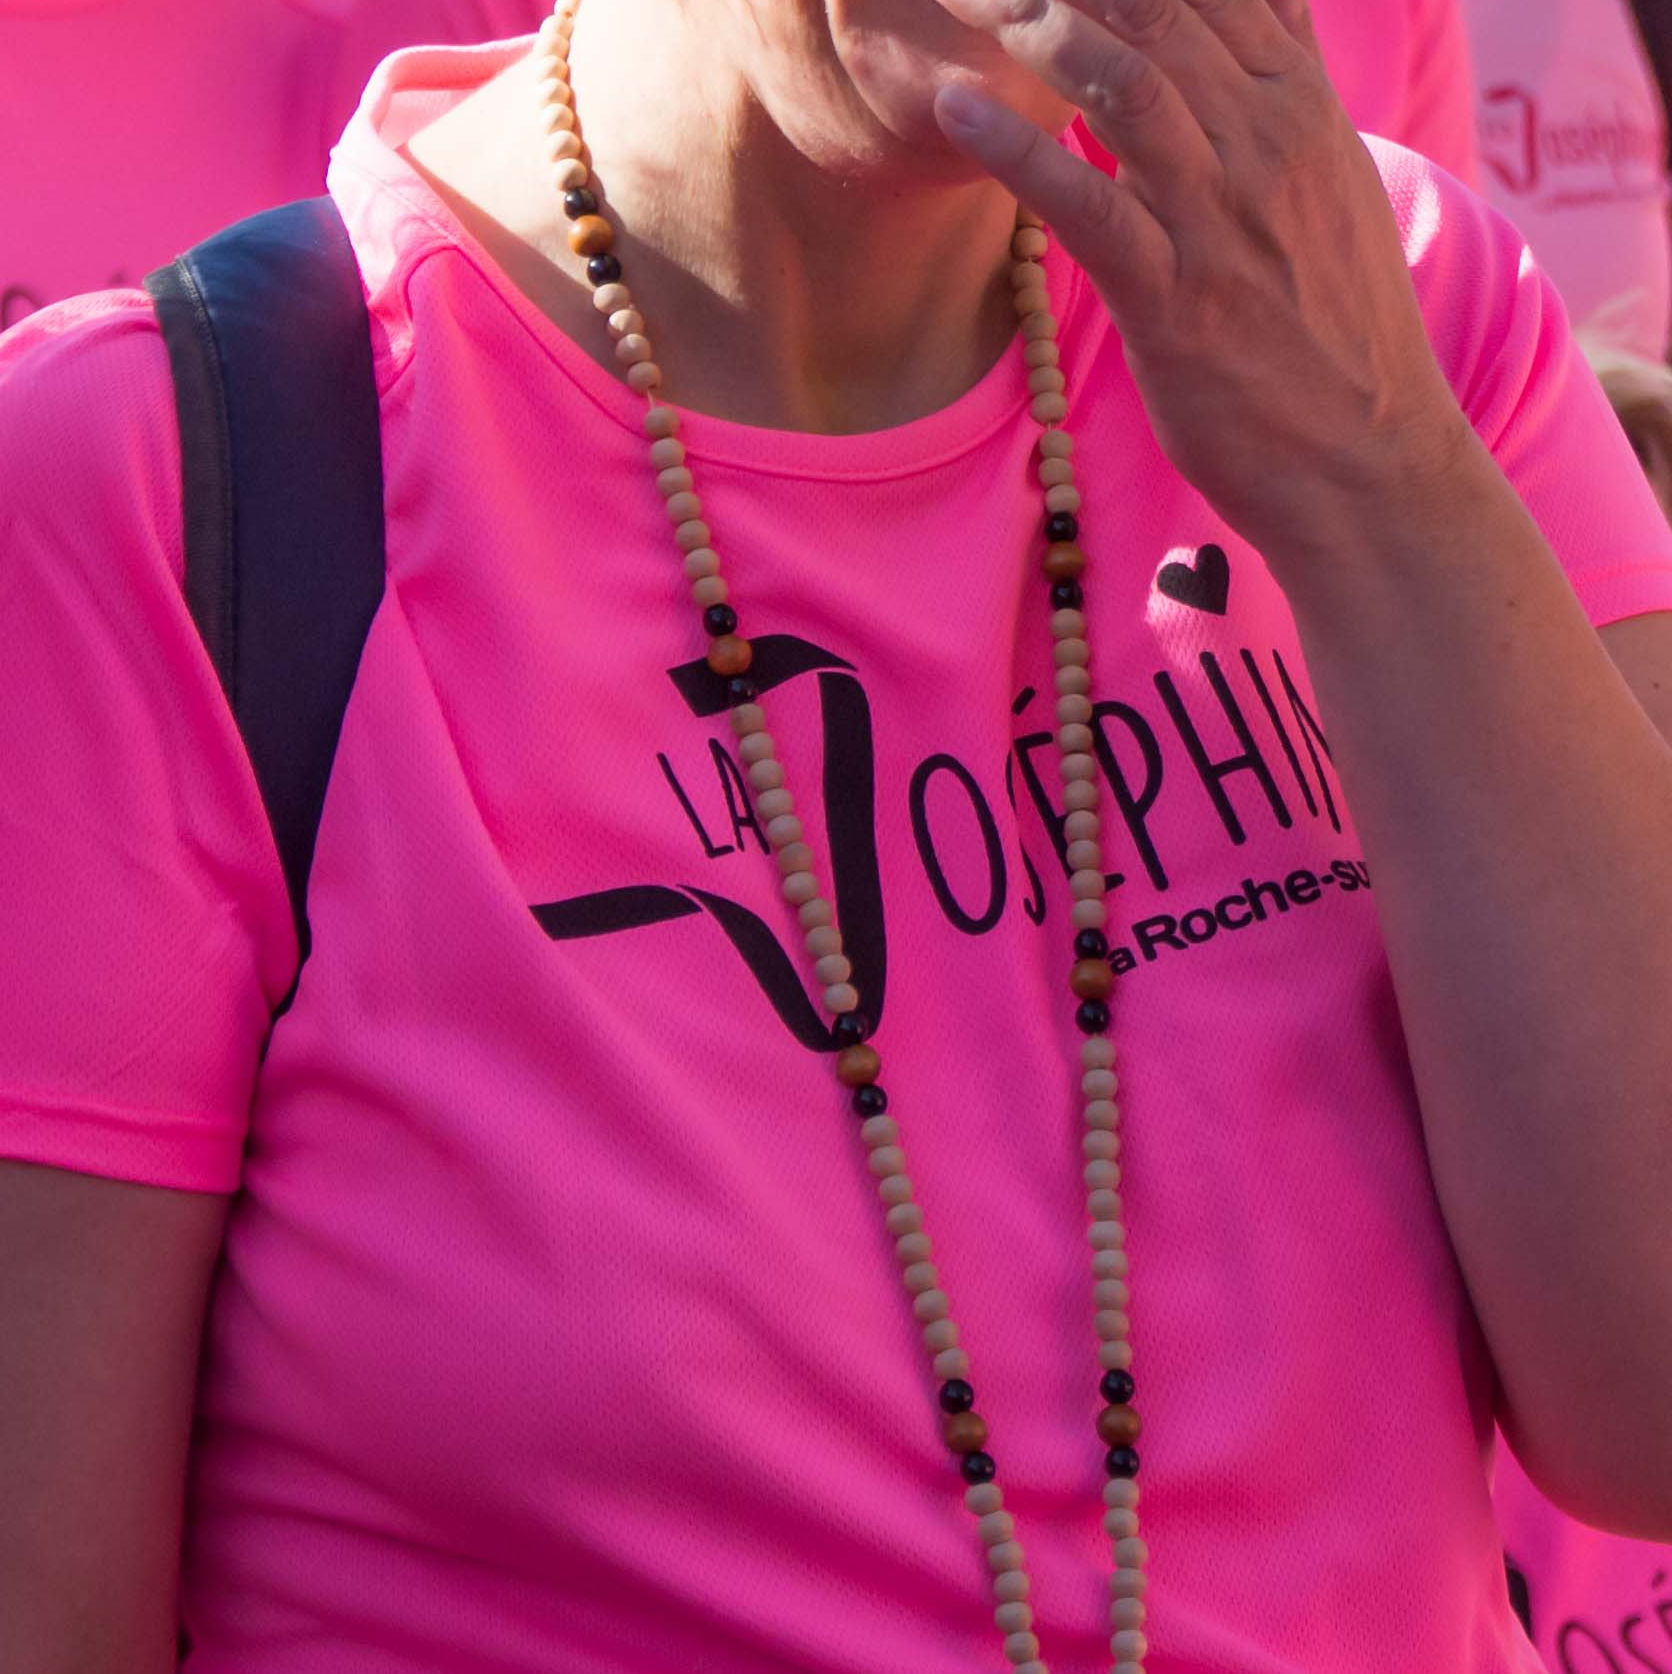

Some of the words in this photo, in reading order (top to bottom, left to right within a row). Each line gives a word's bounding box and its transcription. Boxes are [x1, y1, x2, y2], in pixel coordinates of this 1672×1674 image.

[529, 634, 1341, 1053] JOSÉPHIN
[656, 737, 771, 859] LA
[1104, 946, 1139, 977] a
[1131, 859, 1372, 963] Roche-su
